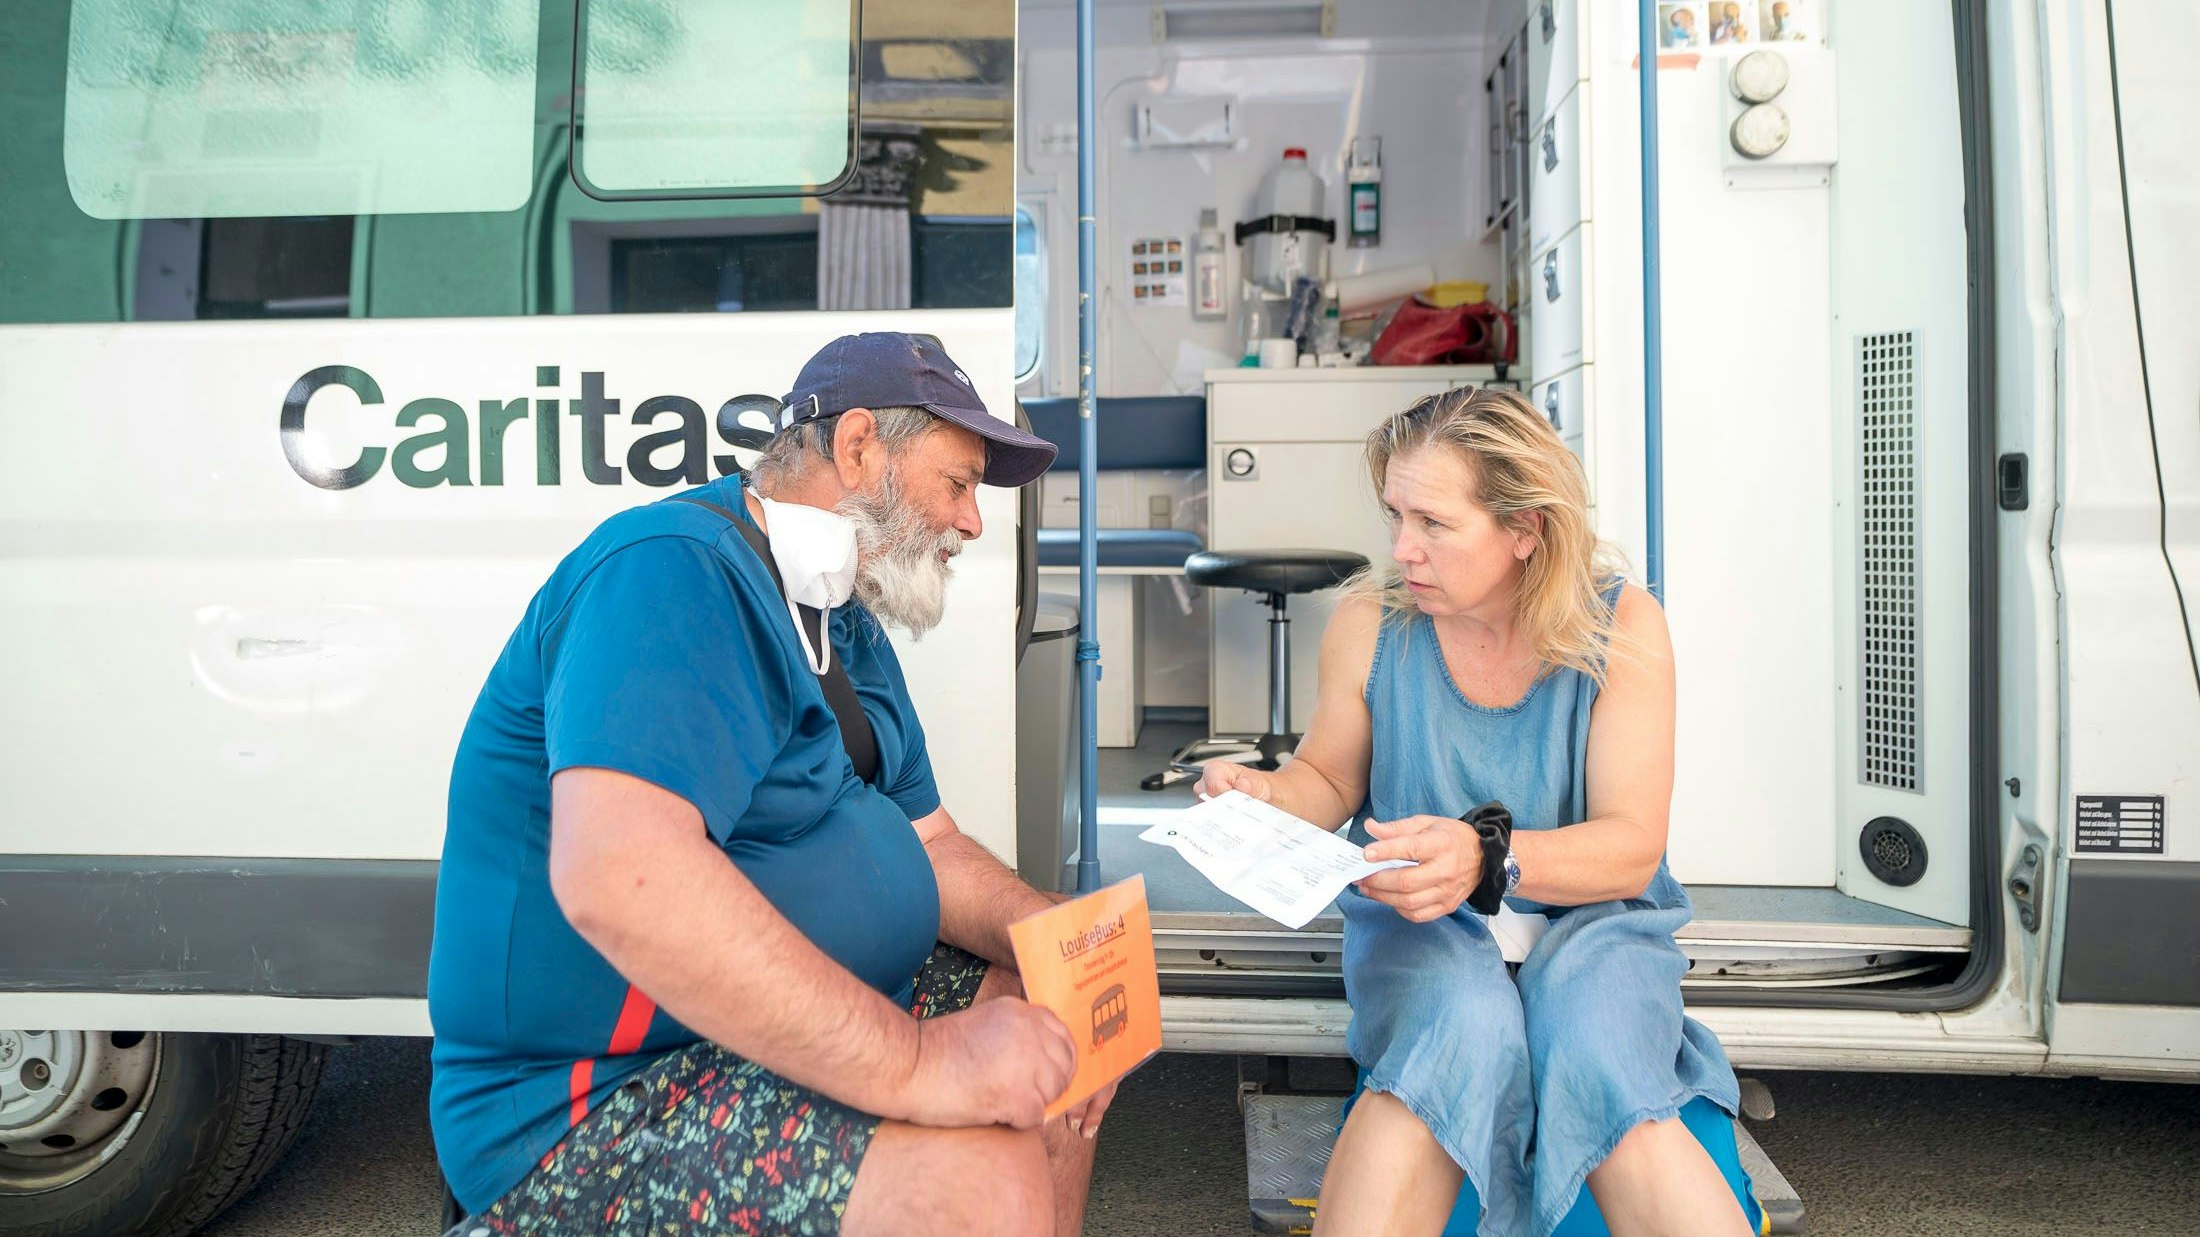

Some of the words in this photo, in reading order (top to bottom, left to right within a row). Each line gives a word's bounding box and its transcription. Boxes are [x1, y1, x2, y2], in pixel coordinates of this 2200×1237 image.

[280, 364, 784, 491] Caritas
[1059, 922, 1117, 957] LouiseBus:
[1118, 914, 1125, 930] 4
